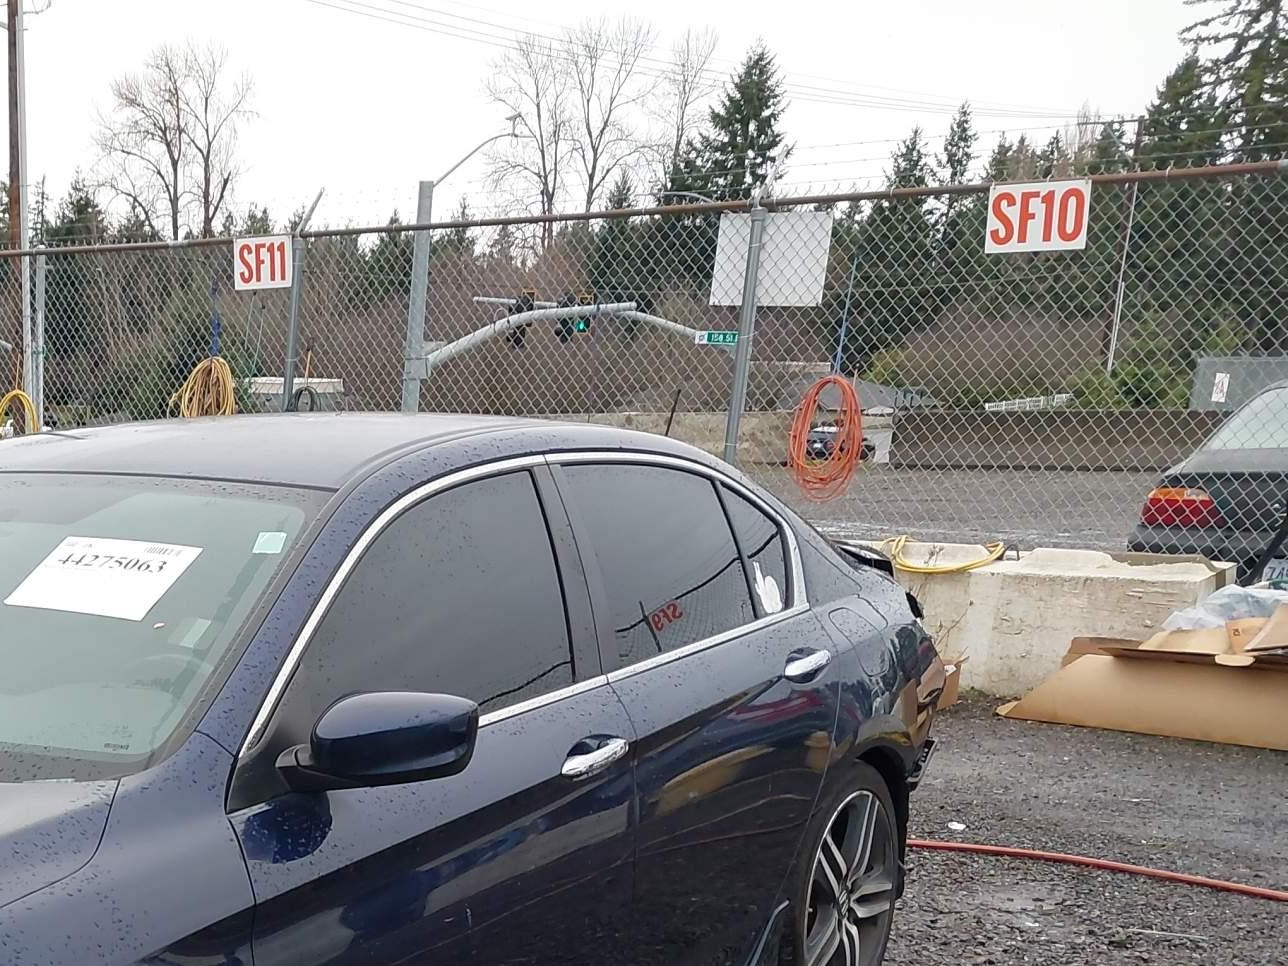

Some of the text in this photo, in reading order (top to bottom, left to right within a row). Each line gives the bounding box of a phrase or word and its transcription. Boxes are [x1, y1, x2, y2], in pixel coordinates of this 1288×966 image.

[989, 186, 1085, 246] SF10
[238, 240, 287, 284] SF11
[57, 552, 168, 574] 44275063
